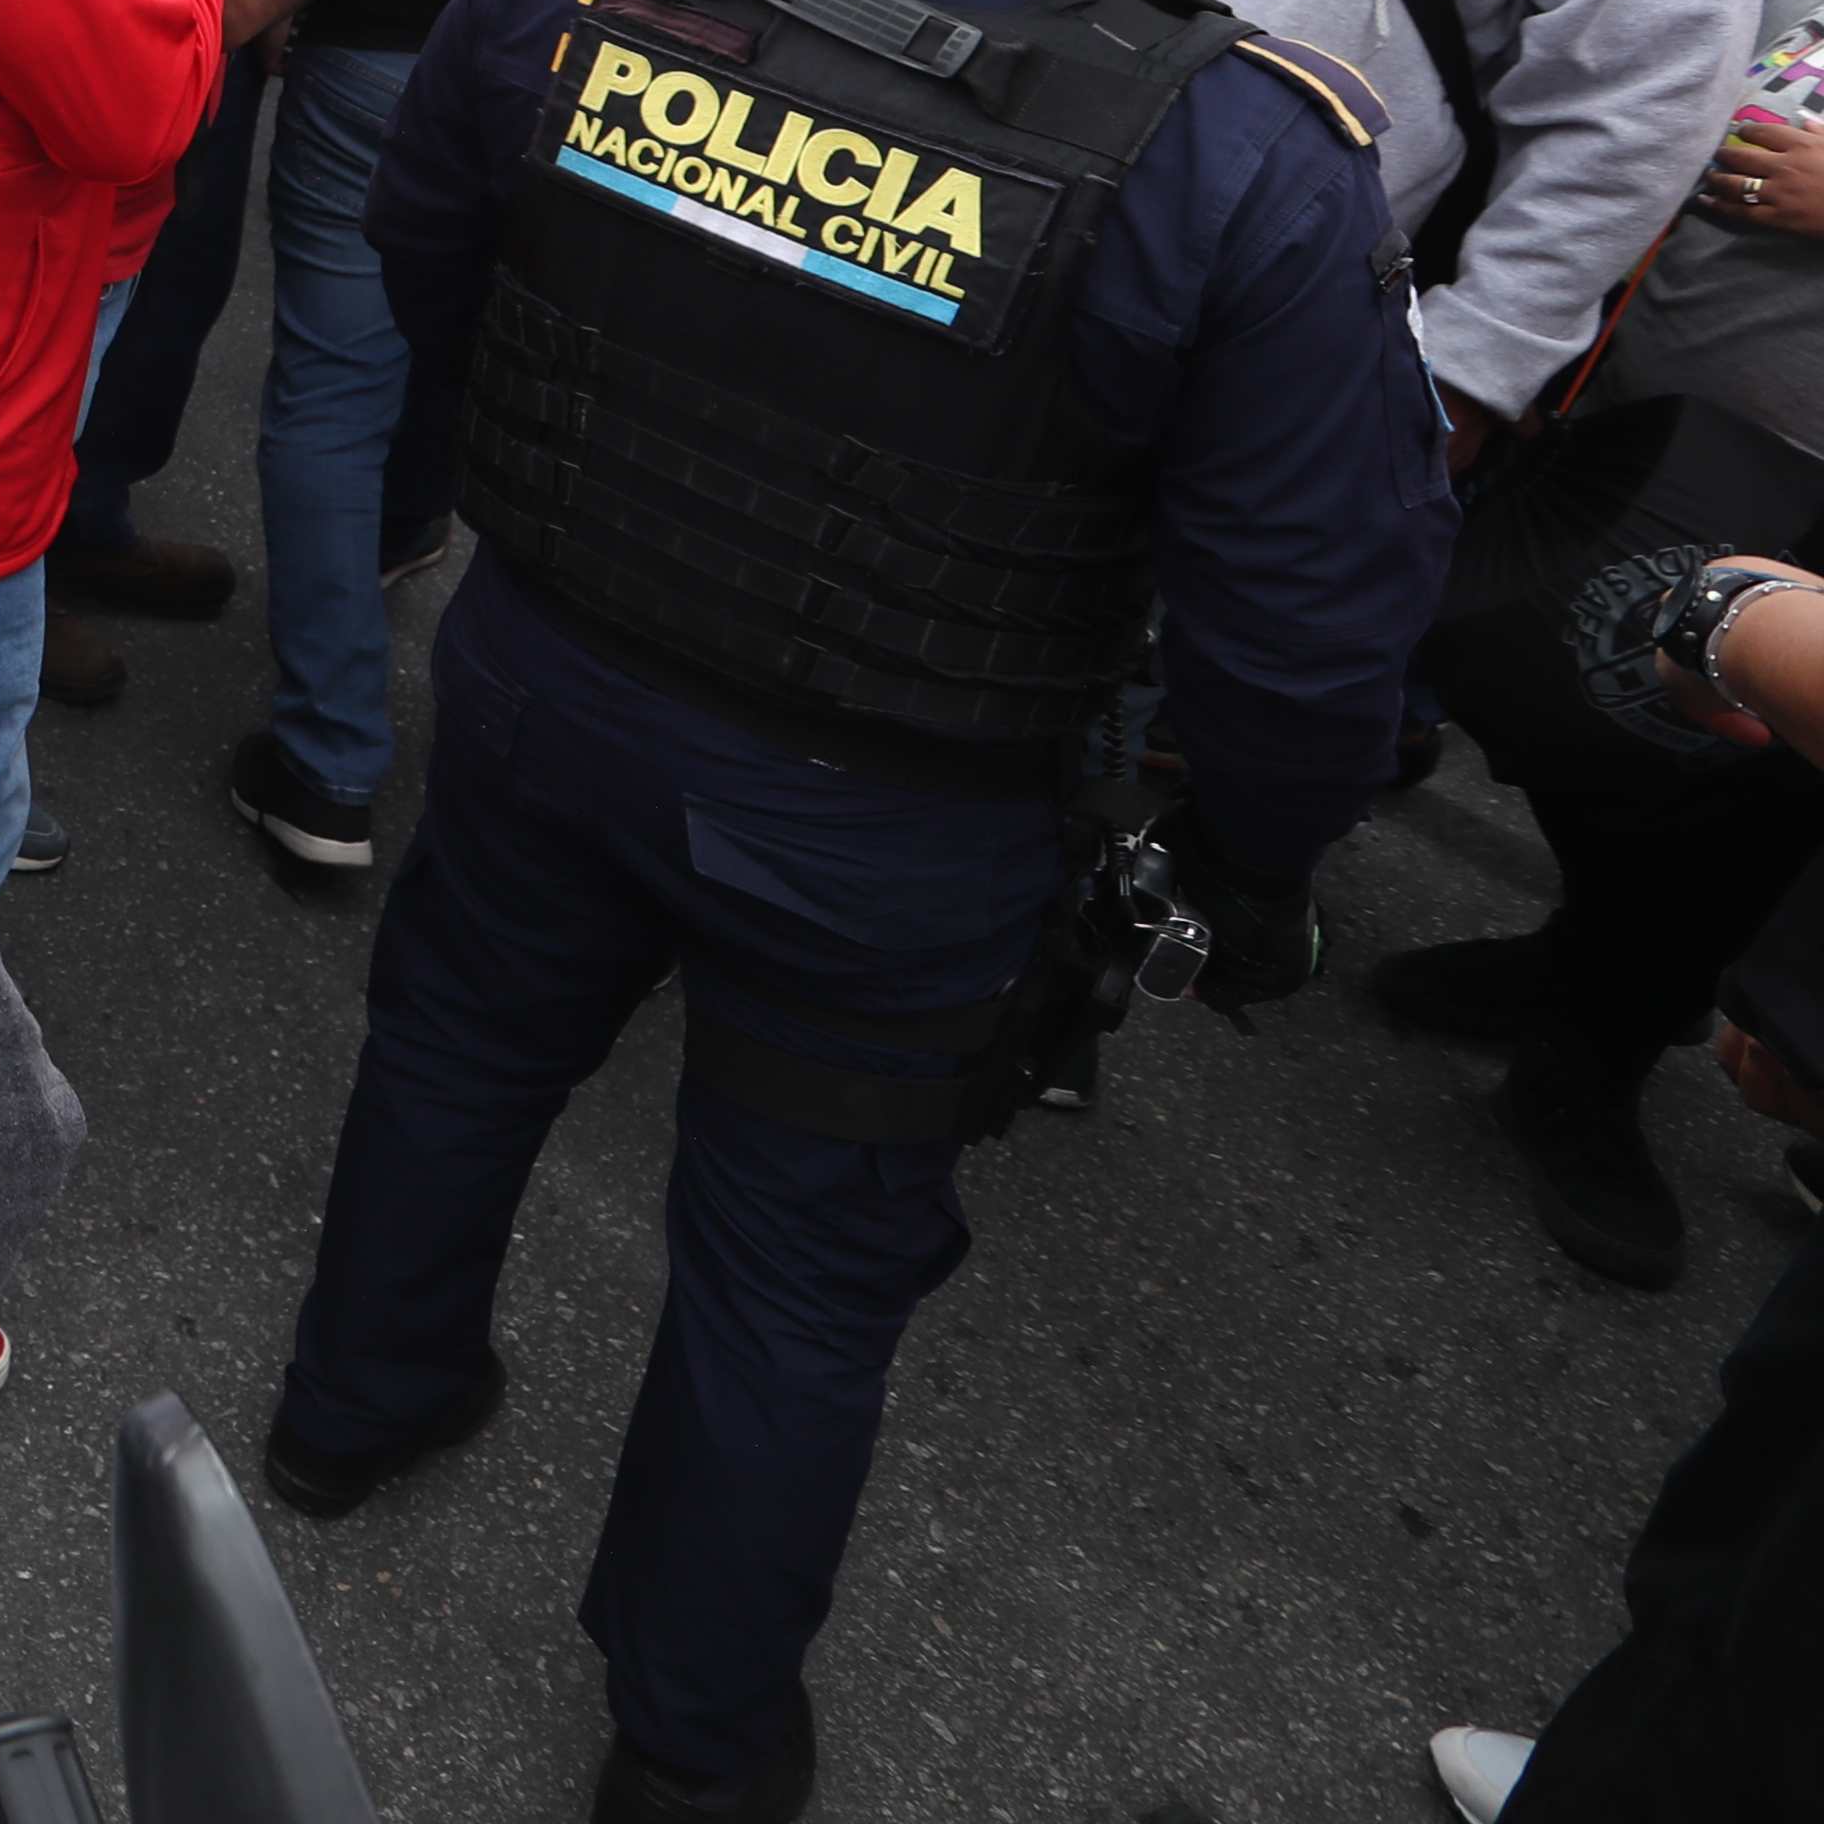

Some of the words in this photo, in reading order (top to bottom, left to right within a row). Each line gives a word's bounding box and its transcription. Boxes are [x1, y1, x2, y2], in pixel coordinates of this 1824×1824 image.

[567, 110, 806, 241] NACIONAL
[821, 214, 966, 300] CIVIL
[577, 39, 984, 258] POLICIA
